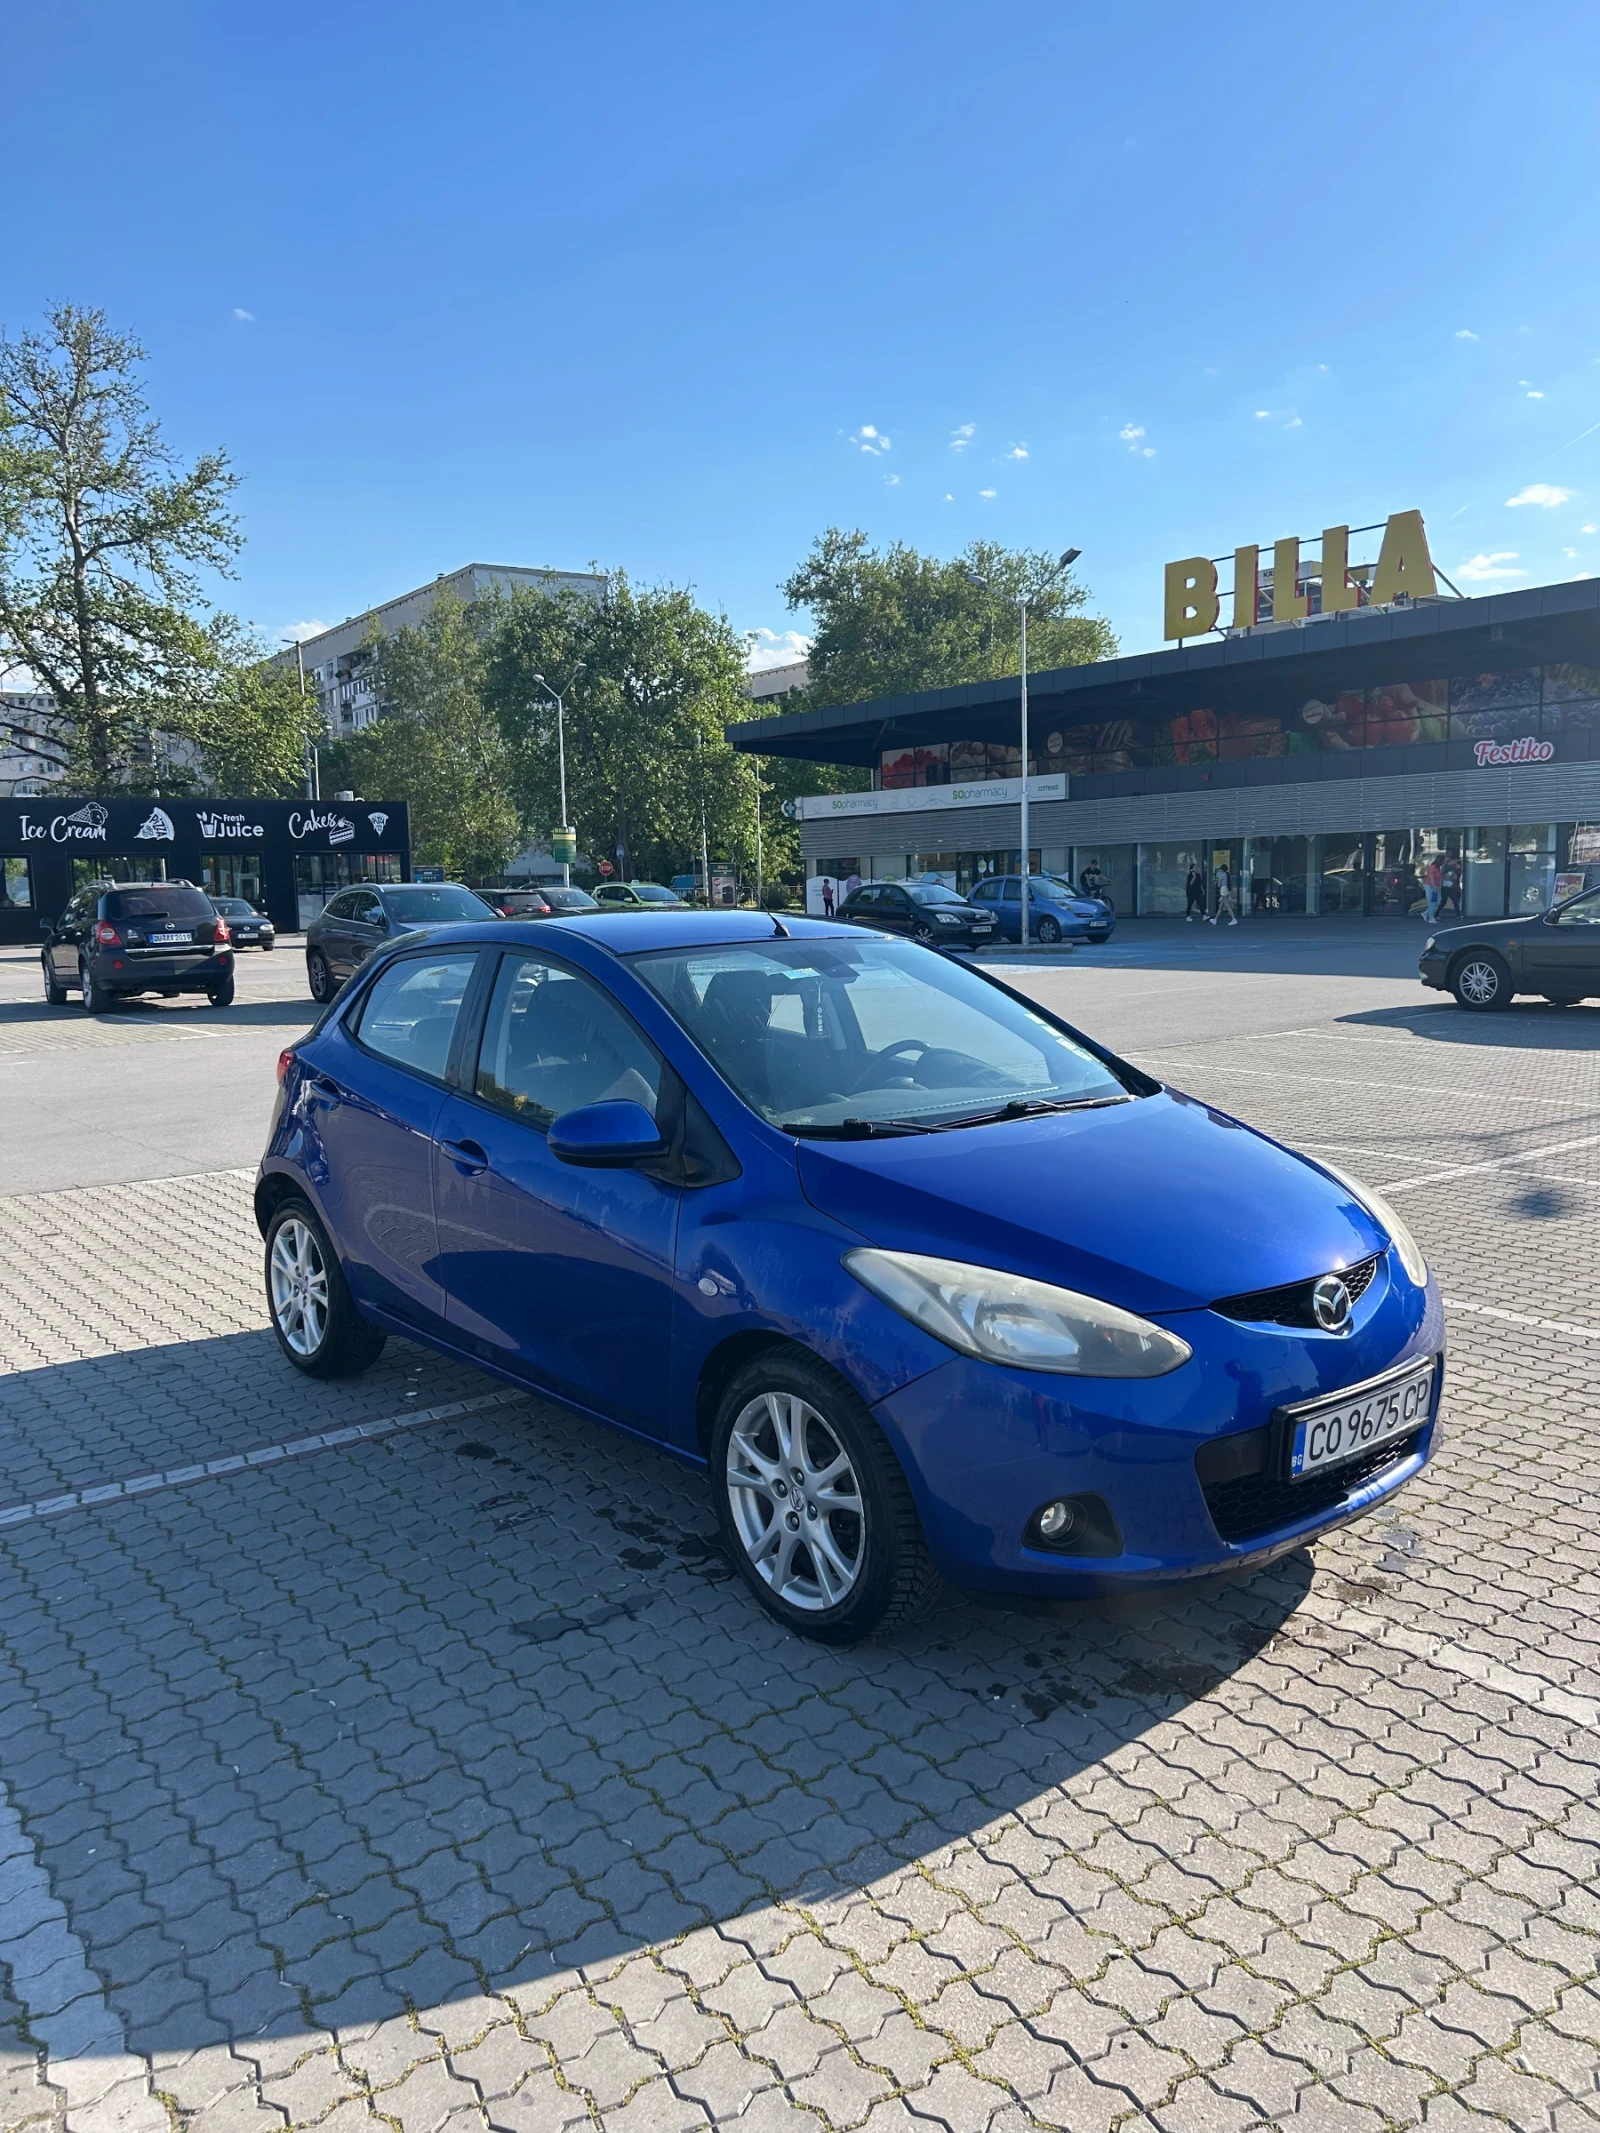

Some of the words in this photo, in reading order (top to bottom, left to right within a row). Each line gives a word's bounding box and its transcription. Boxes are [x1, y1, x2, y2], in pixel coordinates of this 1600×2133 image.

[1164, 509, 1438, 641] BILLA
[1474, 736, 1554, 767] Festiko
[19, 815, 47, 841] Ice
[51, 815, 107, 843] Cream
[217, 821, 265, 838] Juice
[223, 813, 246, 822] Fresh
[289, 808, 337, 839] Cakes
[1309, 1416, 1342, 1461] CO
[1348, 1392, 1400, 1447] 9675
[1403, 1378, 1429, 1421] CP
[1291, 1453, 1303, 1467] BG
